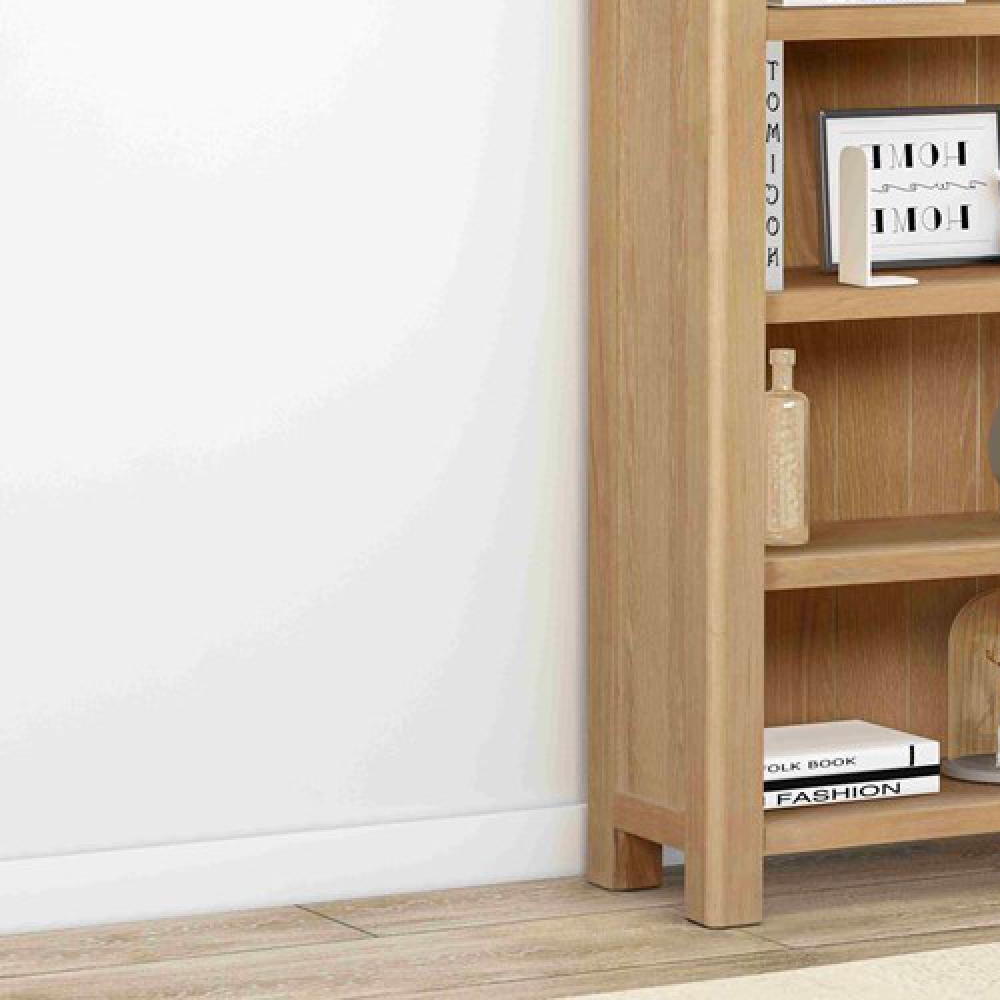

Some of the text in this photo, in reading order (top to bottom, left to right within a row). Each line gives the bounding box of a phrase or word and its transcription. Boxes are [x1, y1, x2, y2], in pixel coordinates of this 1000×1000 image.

[764, 756, 857, 773] OLK BOOK
[777, 782, 901, 806] FASHION
